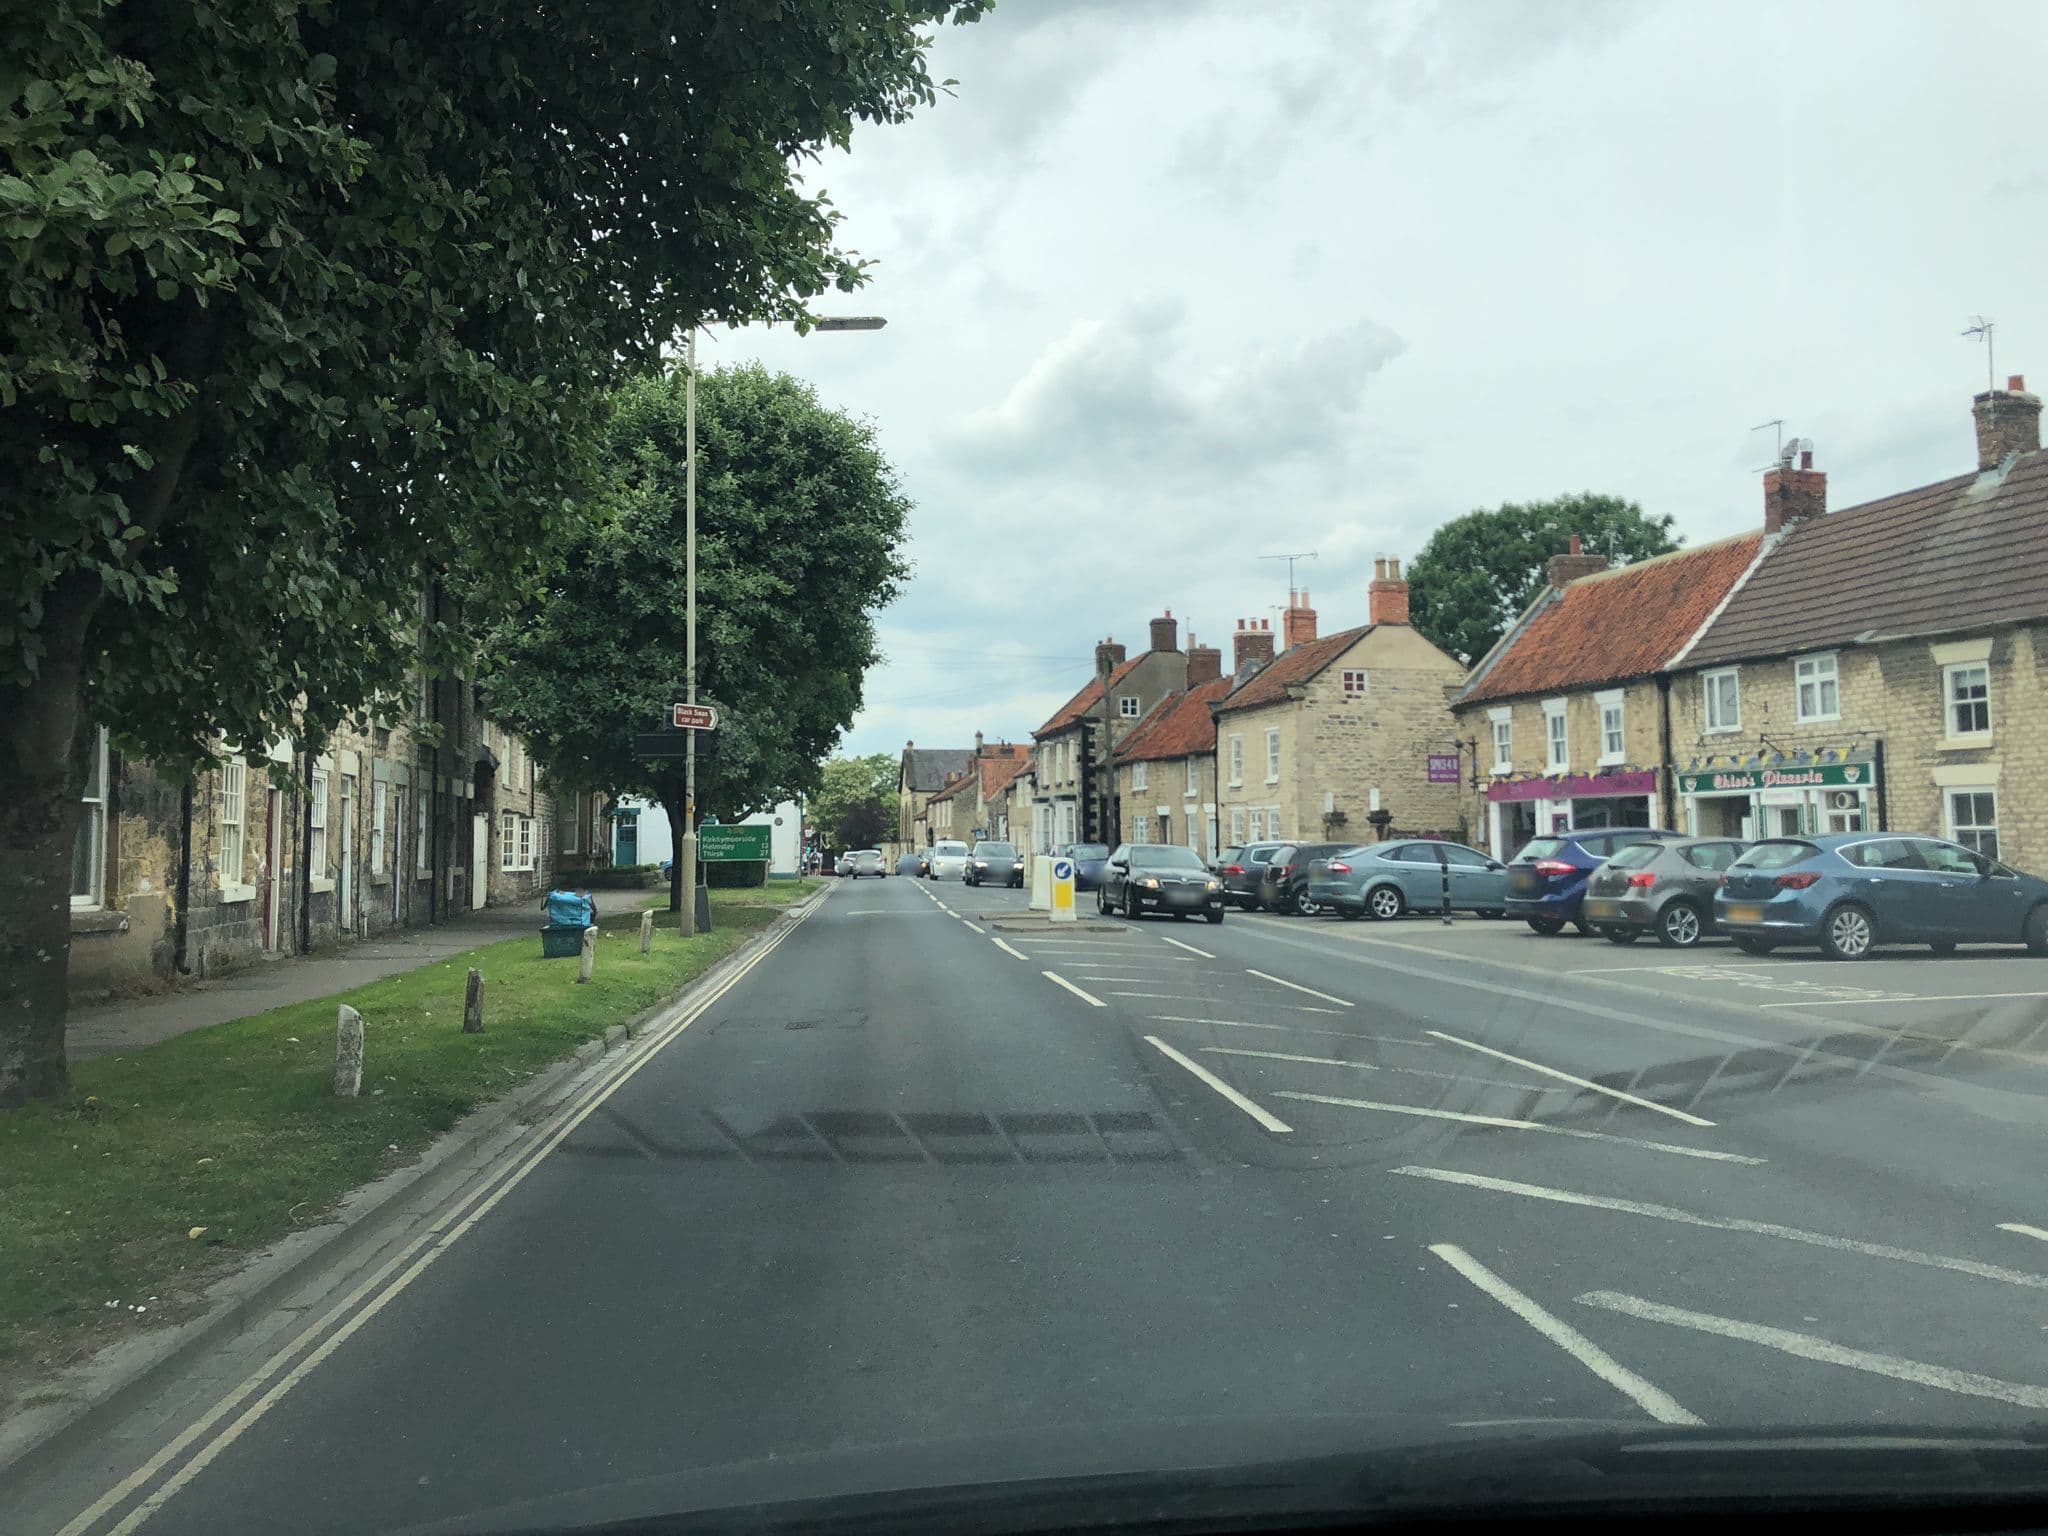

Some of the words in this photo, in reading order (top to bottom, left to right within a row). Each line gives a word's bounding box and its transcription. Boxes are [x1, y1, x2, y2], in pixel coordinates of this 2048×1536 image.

[677, 707, 693, 715] Black
[1761, 769, 1824, 788] Pizzeria
[702, 843, 735, 851] Helmsley
[759, 849, 769, 857] 27
